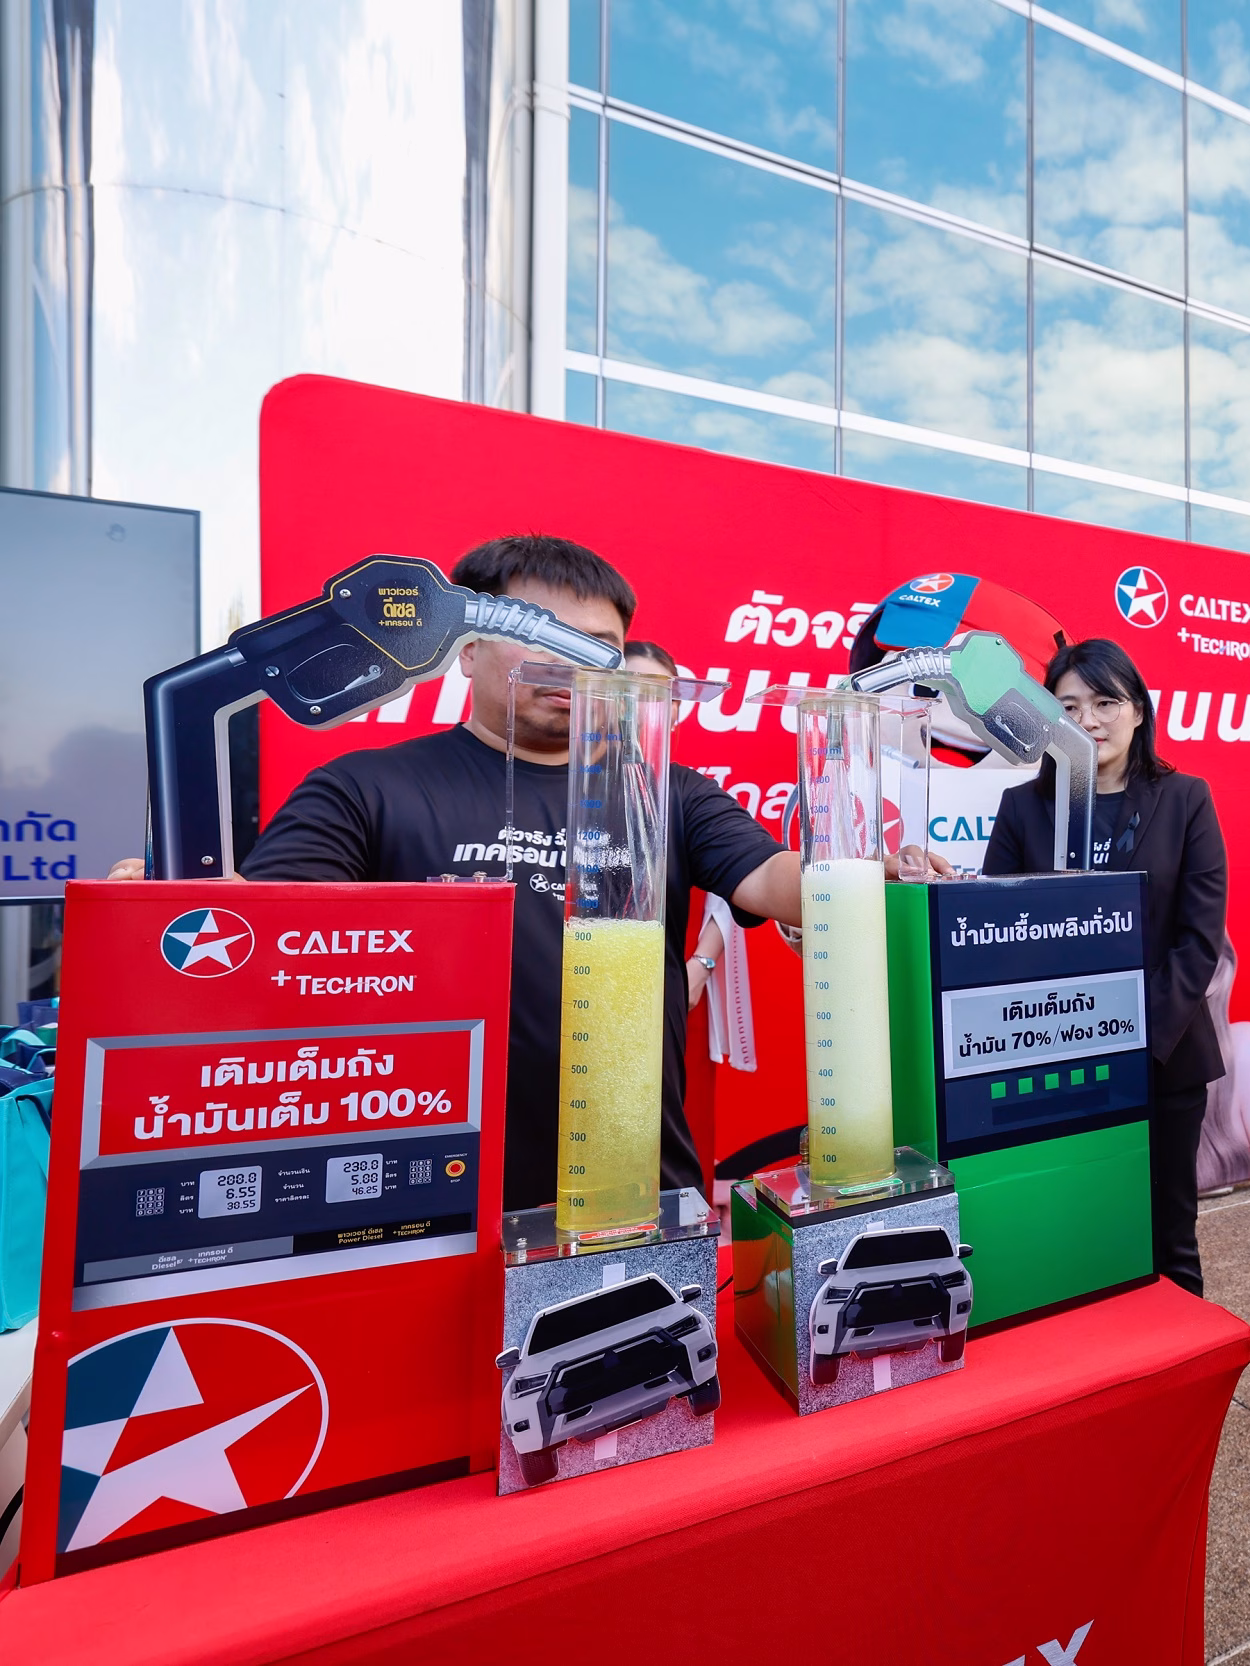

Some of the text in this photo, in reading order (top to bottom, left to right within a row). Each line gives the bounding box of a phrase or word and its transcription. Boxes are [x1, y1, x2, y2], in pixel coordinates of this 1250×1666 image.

[378, 586, 419, 596] พาวเวอร์
[899, 594, 942, 608] CALTEX
[383, 597, 416, 618] ดีเซล
[416, 618, 423, 627] ดี
[928, 816, 996, 842] CAL
[578, 831, 600, 840] 1200
[3, 854, 76, 881] Ltd
[811, 863, 830, 872] 1100
[811, 892, 831, 902] 1000
[813, 923, 829, 932] 900
[951, 906, 1133, 947] น้ำมันเชื้อเพลิงทั่วไป
[574, 931, 592, 941] 900
[277, 930, 415, 956] CALTEX
[813, 951, 828, 960] 800
[573, 966, 591, 975] 800
[814, 981, 829, 990] 700
[572, 1000, 589, 1009] 700
[1002, 992, 1095, 1022] เติมเต็มถัง
[816, 1011, 832, 1020] 600
[572, 1032, 589, 1042] 600
[959, 1033, 1006, 1058] น้ำมัน
[1097, 1018, 1135, 1037] 30%
[817, 1039, 833, 1048] 500
[200, 1046, 394, 1088] เติมเต็มถัง
[571, 1065, 588, 1074] 500
[818, 1069, 833, 1077] 400
[569, 1100, 586, 1109] 400
[820, 1098, 836, 1107] 300
[133, 1088, 452, 1140] น้ำมันเต็ม 100%
[821, 1126, 837, 1135] 200
[569, 1132, 586, 1142] 300
[821, 1154, 837, 1163] 100
[343, 1159, 379, 1173] 230.0
[568, 1165, 585, 1174] 200
[351, 1173, 379, 1186] 5.00
[226, 1186, 256, 1199] 6.55
[352, 1185, 378, 1195] 46.25
[227, 1199, 256, 1211] 30.55
[568, 1197, 585, 1207] 100
[362, 1233, 383, 1241] Diesel
[151, 1261, 176, 1270] Diesel
